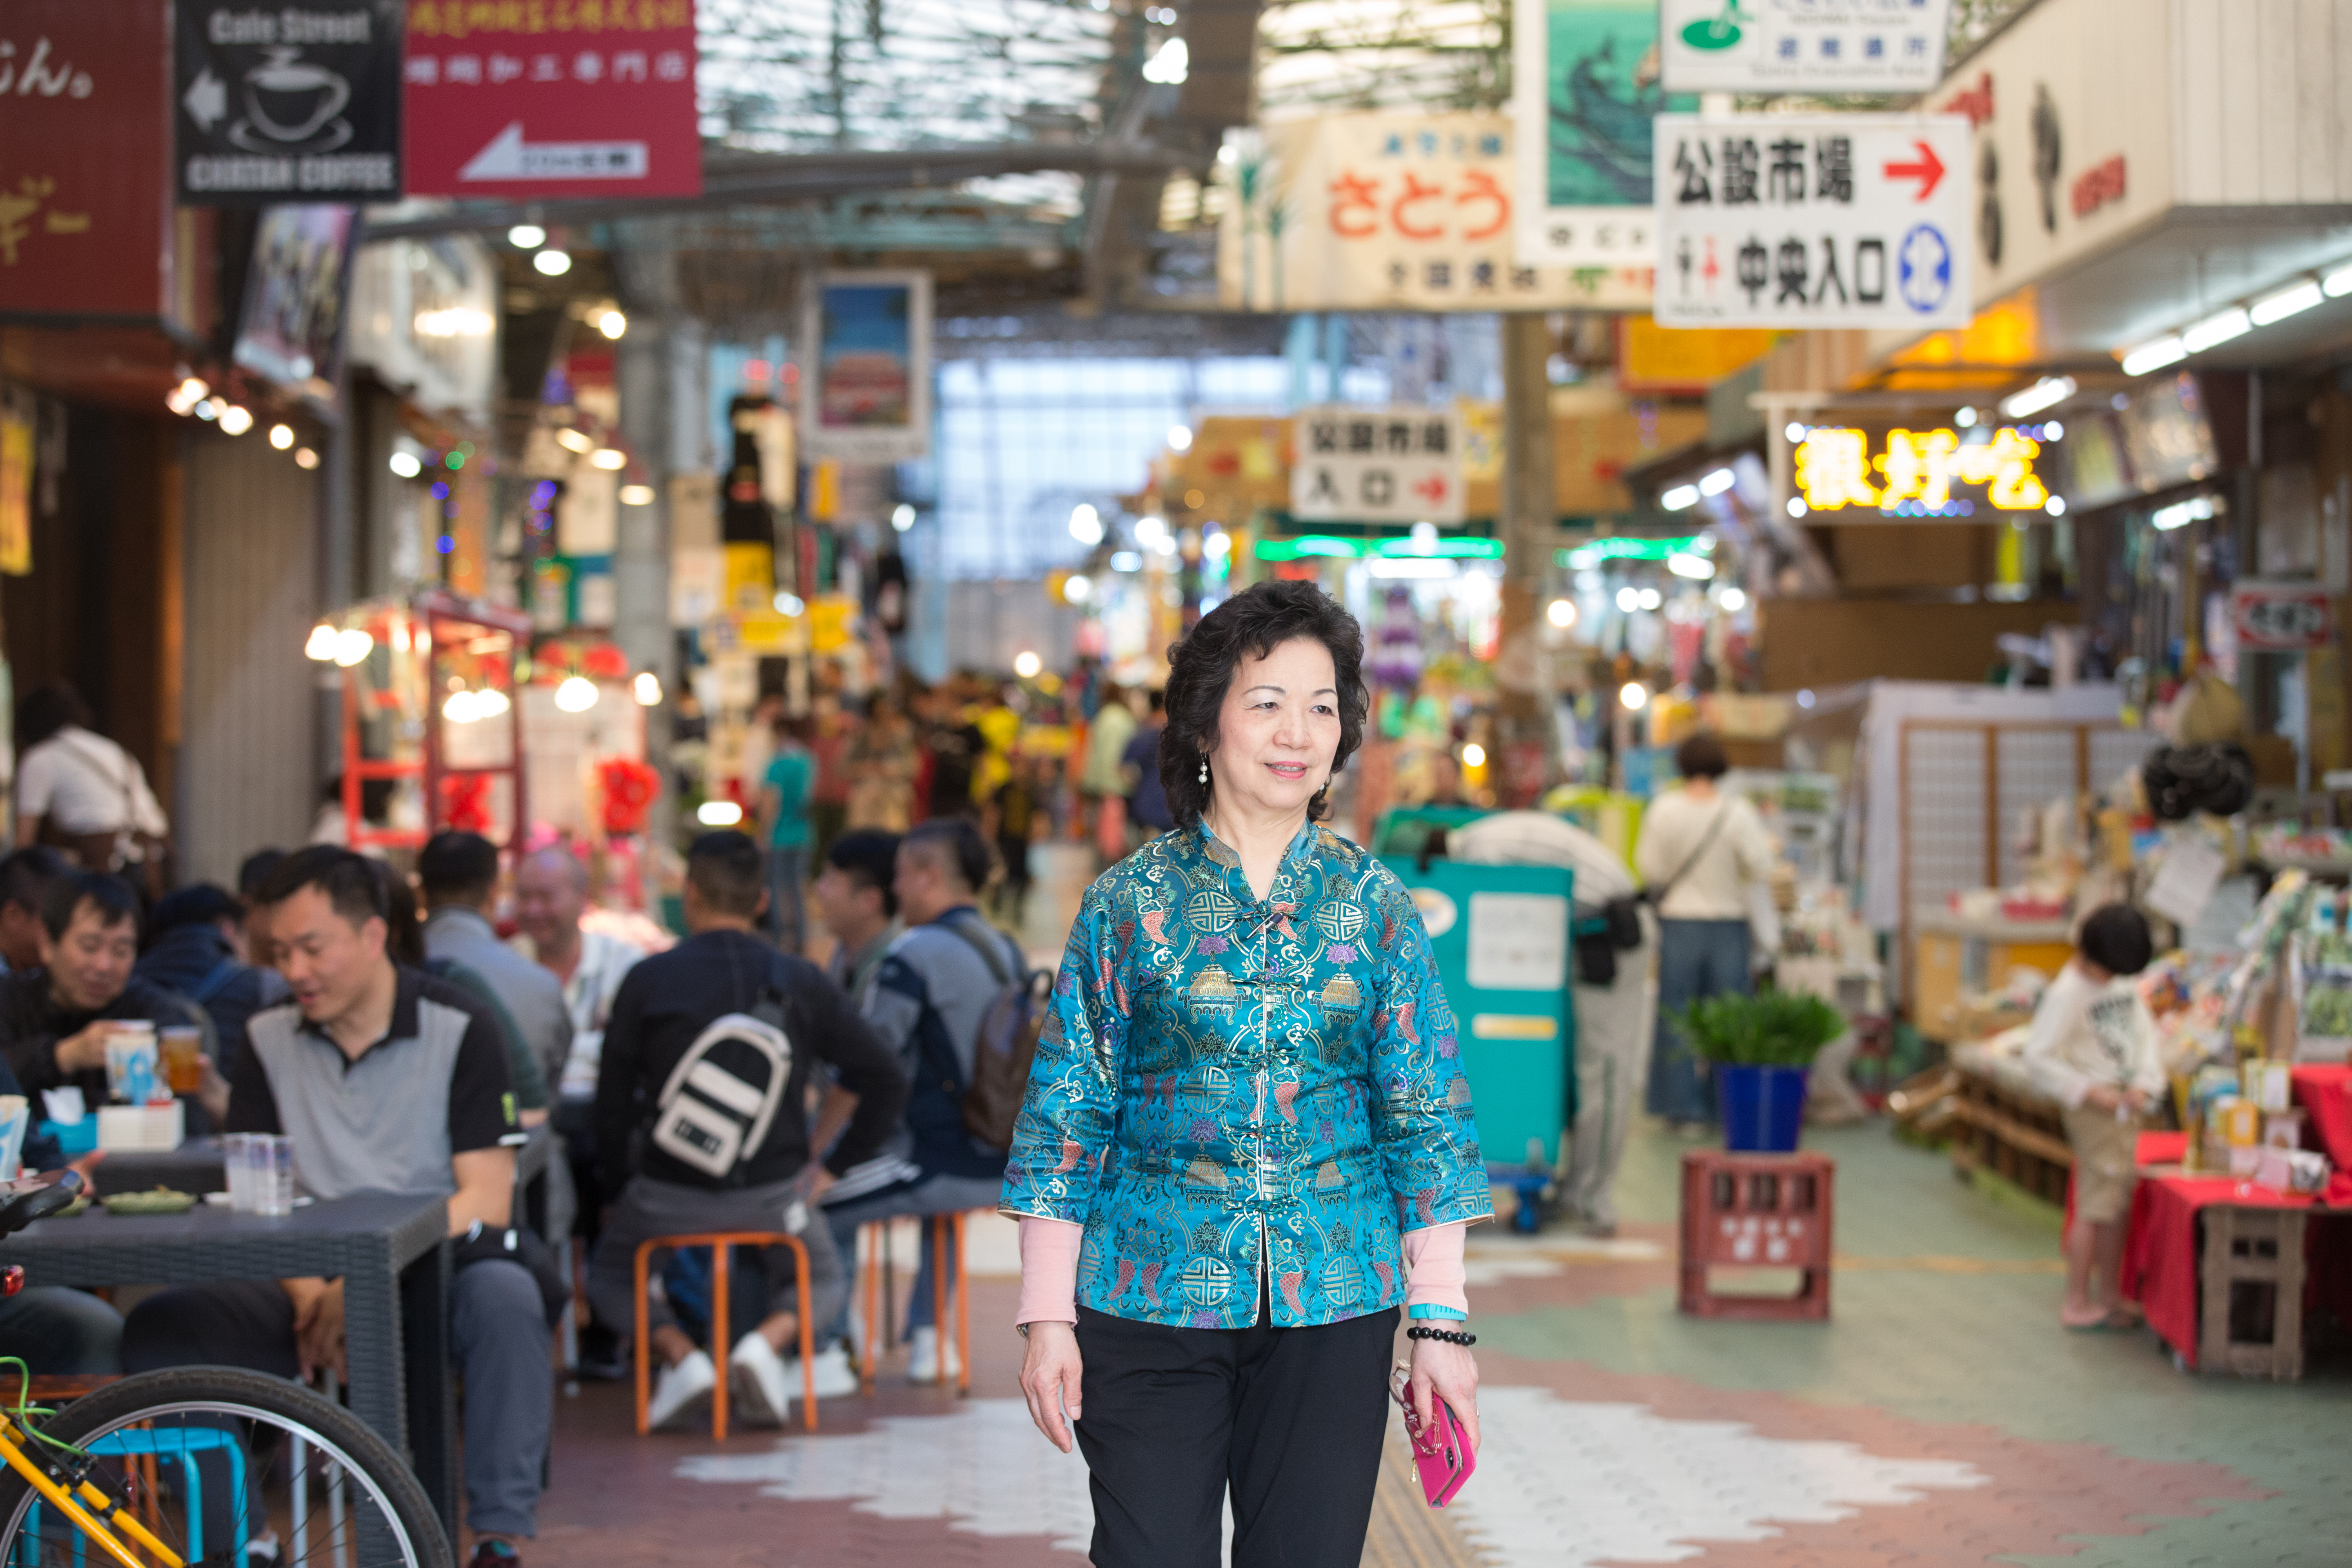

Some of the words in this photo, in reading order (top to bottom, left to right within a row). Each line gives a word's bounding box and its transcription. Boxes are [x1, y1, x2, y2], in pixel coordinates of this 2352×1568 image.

[1328, 168, 1512, 242] さとう
[1675, 134, 1855, 206] 公設市場
[1736, 237, 1886, 306] 中央入口
[1308, 469, 1394, 503] 入口
